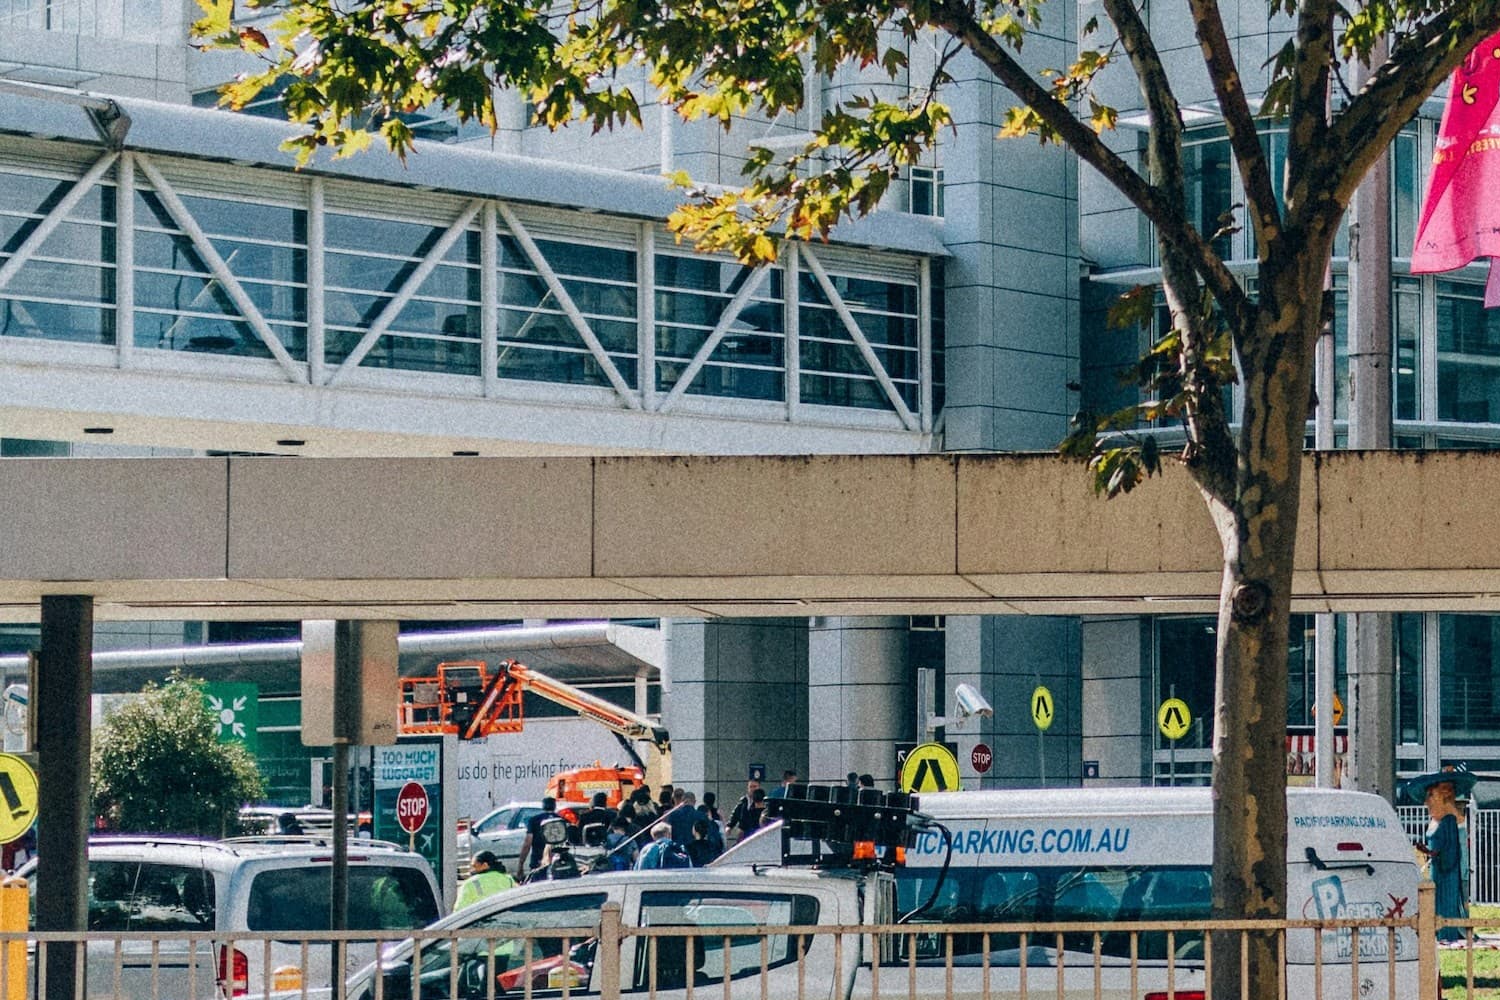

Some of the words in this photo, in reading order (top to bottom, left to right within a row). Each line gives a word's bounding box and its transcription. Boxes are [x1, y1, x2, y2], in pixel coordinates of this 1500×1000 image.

[382, 751, 403, 765] TOO
[405, 750, 436, 765] MUCH
[973, 752, 991, 764] STOP
[457, 765, 471, 780] us
[473, 760, 488, 780] do
[493, 760, 513, 780] the
[400, 797, 426, 816] STOP
